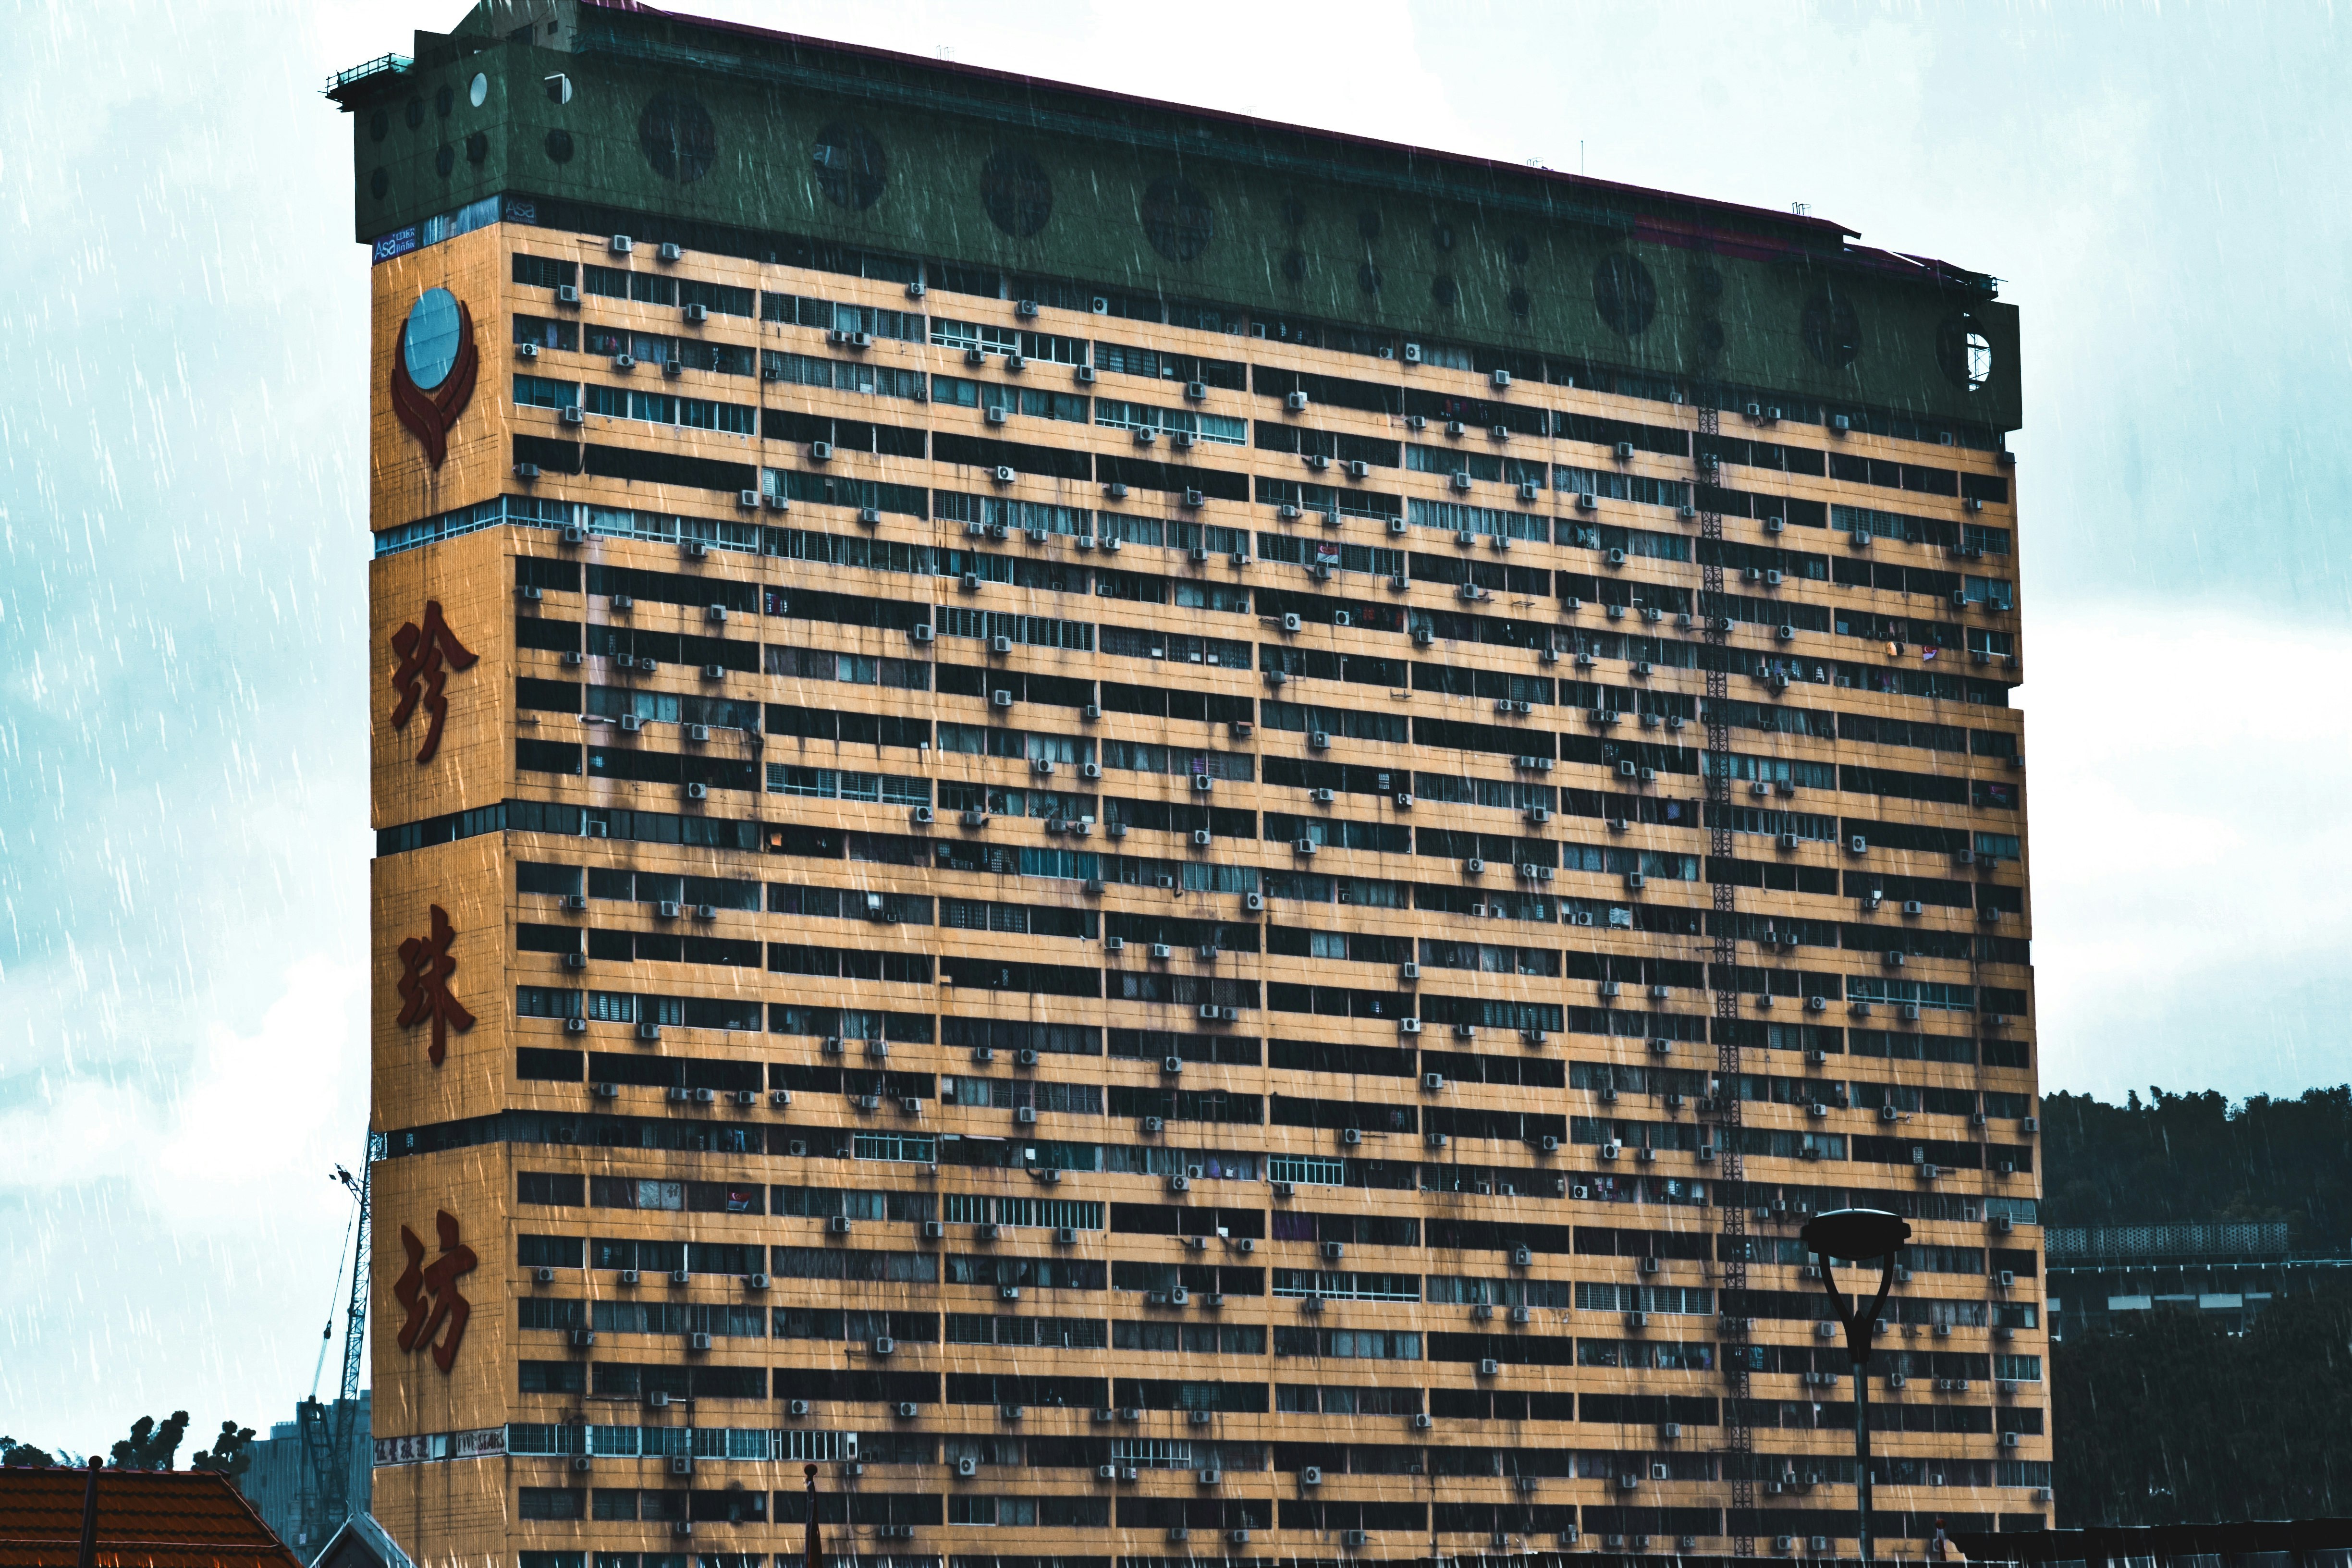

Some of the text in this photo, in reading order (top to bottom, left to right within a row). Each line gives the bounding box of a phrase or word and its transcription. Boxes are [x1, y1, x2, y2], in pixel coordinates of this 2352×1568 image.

[506, 200, 534, 218] Asa
[374, 240, 395, 260] Asa
[458, 1430, 505, 1452] FIVE STARS
